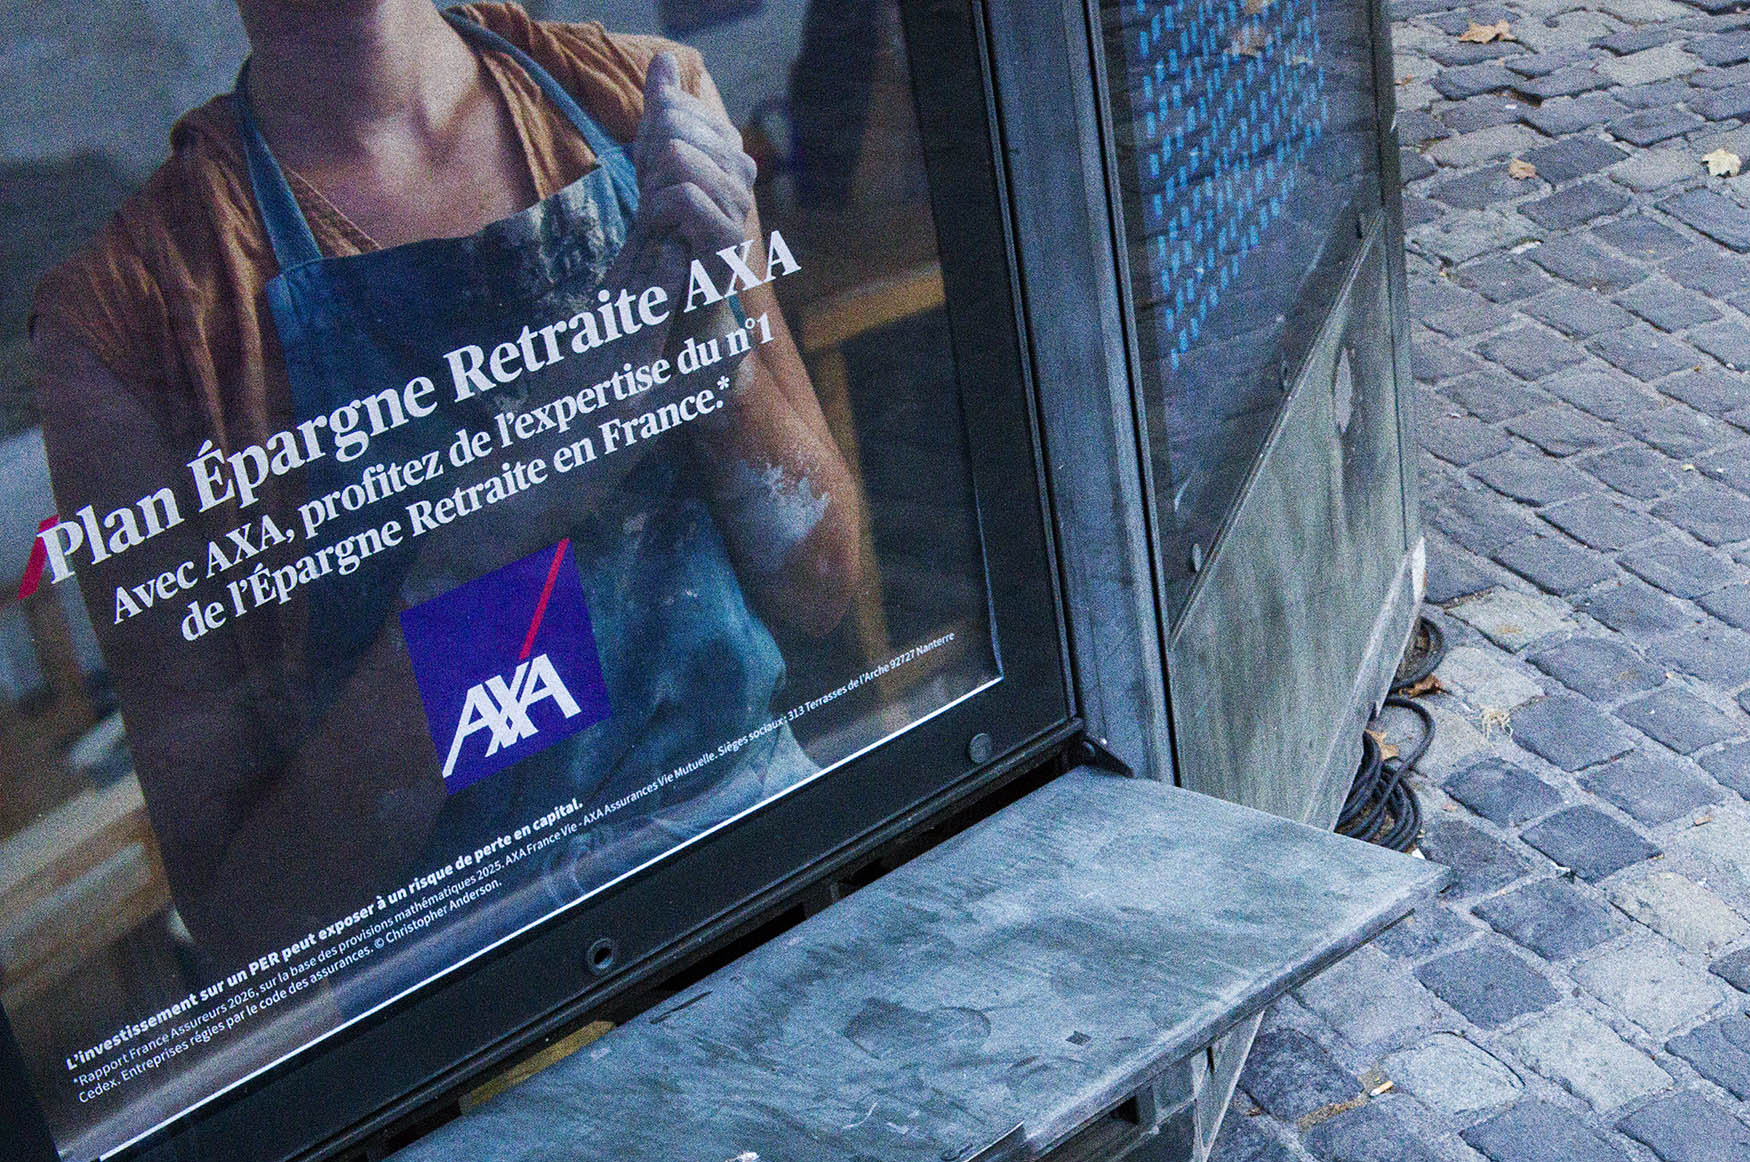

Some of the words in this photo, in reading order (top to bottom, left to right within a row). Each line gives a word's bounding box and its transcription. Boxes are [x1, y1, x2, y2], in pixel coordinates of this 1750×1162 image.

[36, 487, 185, 585] Plan
[186, 376, 438, 513] Épargne
[443, 286, 670, 403] Retraite
[683, 230, 802, 313] AXA
[114, 561, 198, 625] Avec
[206, 514, 295, 579] AXA,
[297, 450, 444, 540] profitez
[449, 429, 493, 467] de
[677, 337, 723, 375] du
[181, 600, 226, 641] de
[405, 458, 548, 537] Retraite
[553, 437, 597, 473] en
[442, 653, 582, 779] AXA
[128, 1033, 169, 1060] France
[170, 1003, 228, 1039] Assureurs
[259, 977, 277, 993] sur
[277, 971, 290, 983] la
[289, 957, 317, 977] base
[317, 946, 338, 963] des
[338, 917, 394, 955] provisions
[394, 875, 477, 923] mathématiques
[476, 860, 505, 881] 2025.
[505, 848, 527, 866] AXA
[526, 831, 561, 855] France
[560, 823, 578, 837] Vie
[583, 808, 607, 826] AXA
[604, 781, 659, 815] Assurances
[656, 773, 674, 787] Vie
[673, 752, 718, 779] Mutuelle.
[717, 735, 749, 757] Sièges
[787, 705, 805, 721] 313
[804, 685, 848, 712] Terrasses
[847, 679, 859, 691] de
[889, 648, 915, 670] 92727
[915, 632, 955, 657] Nanterre
[199, 980, 225, 1001] sur
[226, 970, 248, 987] un
[248, 951, 281, 976] PER
[281, 933, 317, 962] peut
[318, 903, 374, 940] exposer
[376, 895, 387, 910] à
[387, 888, 408, 905] un
[408, 864, 454, 894] risque
[455, 855, 473, 870] de
[474, 835, 512, 864] perte
[513, 825, 532, 841] en
[532, 797, 583, 831] capital.
[78, 1078, 121, 1103] Cedex.
[120, 1041, 189, 1081] Entreprises
[189, 1021, 226, 1046] régies
[225, 1010, 245, 1030] par
[245, 1004, 258, 1016] le
[259, 989, 287, 1010] code
[288, 978, 310, 995] des
[309, 946, 374, 984] assurances.
[385, 905, 448, 944] Christopher
[449, 879, 502, 911] Anderson.
